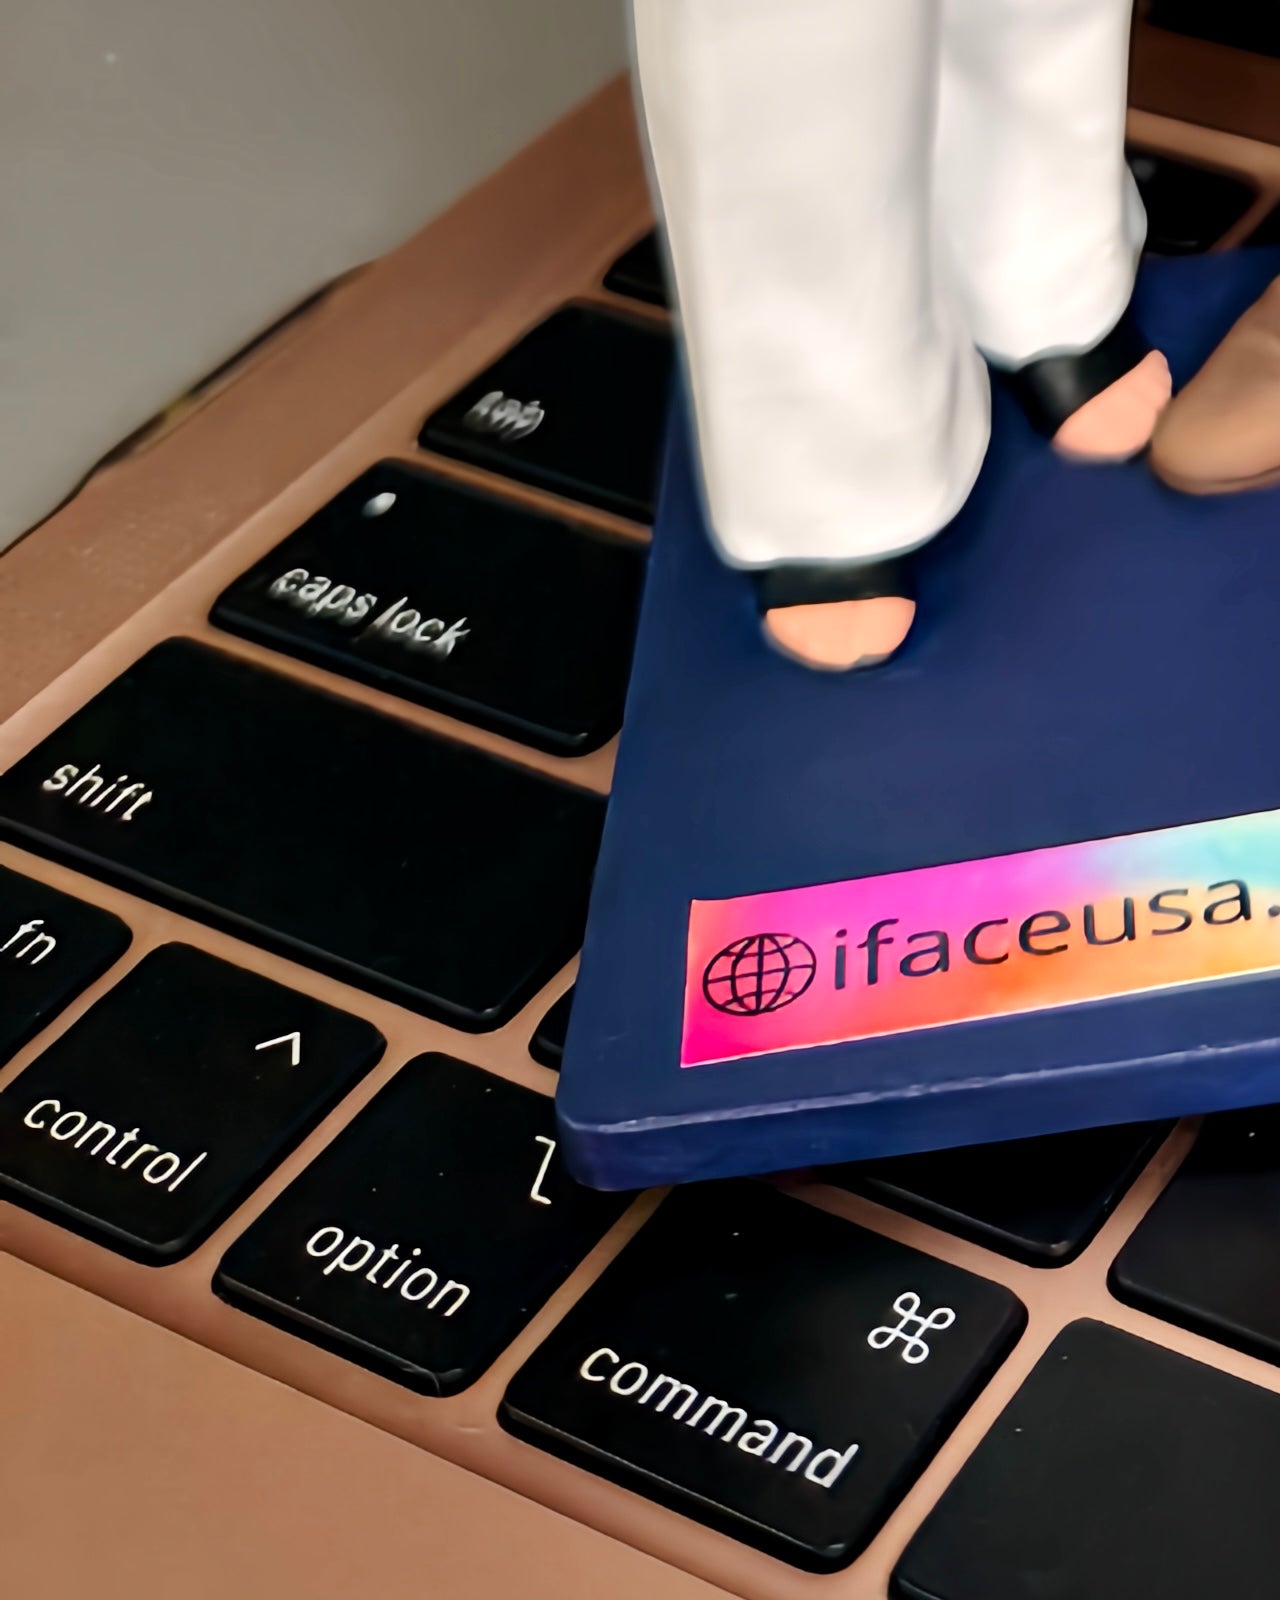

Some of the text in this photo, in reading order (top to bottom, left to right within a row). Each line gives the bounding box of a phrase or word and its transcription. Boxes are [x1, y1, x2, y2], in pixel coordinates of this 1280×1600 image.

[270, 568, 471, 656] caps lock
[42, 763, 153, 821] shift
[0, 919, 57, 965] fn
[23, 1099, 208, 1193] control
[306, 1225, 471, 1318] option
[579, 1347, 860, 1488] command
